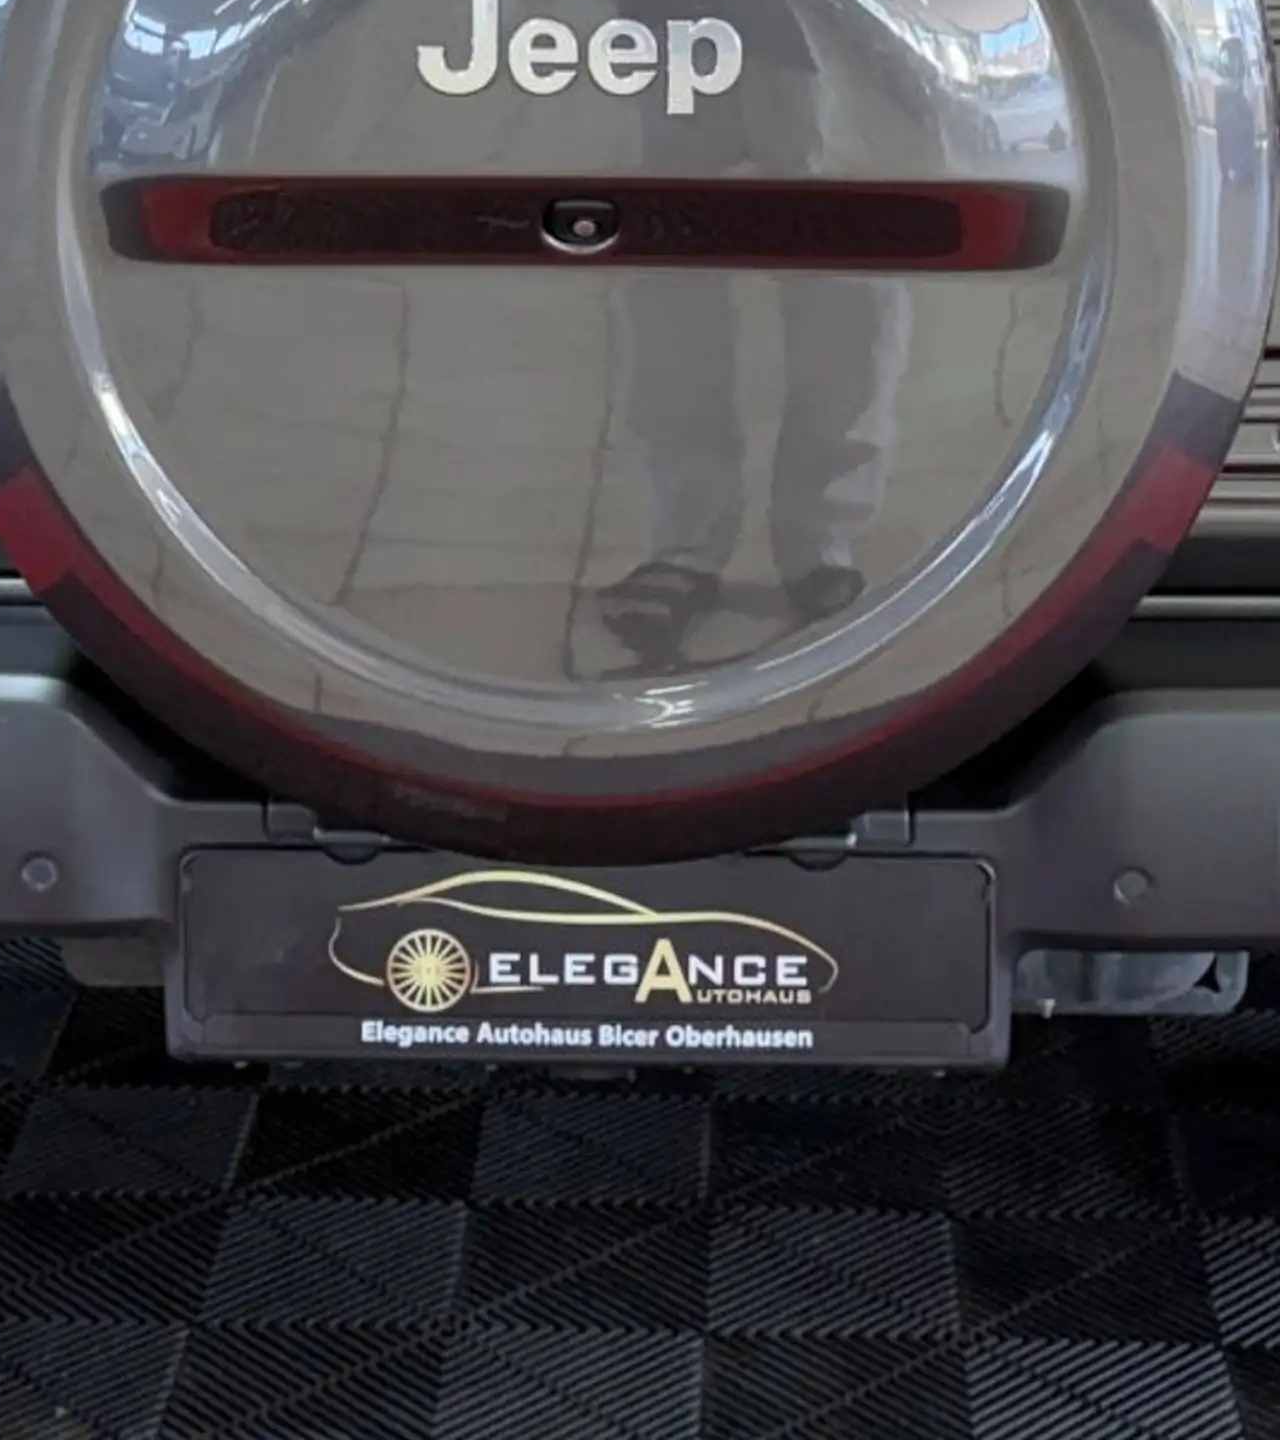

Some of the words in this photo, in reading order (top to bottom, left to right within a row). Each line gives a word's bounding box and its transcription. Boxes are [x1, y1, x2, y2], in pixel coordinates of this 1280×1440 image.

[488, 938, 808, 1003] ELEGANCE
[361, 1020, 470, 1048] Elegance
[477, 1022, 593, 1046] Autohaus
[599, 1023, 658, 1047] Bicer
[665, 1024, 813, 1048] Oberhausen
